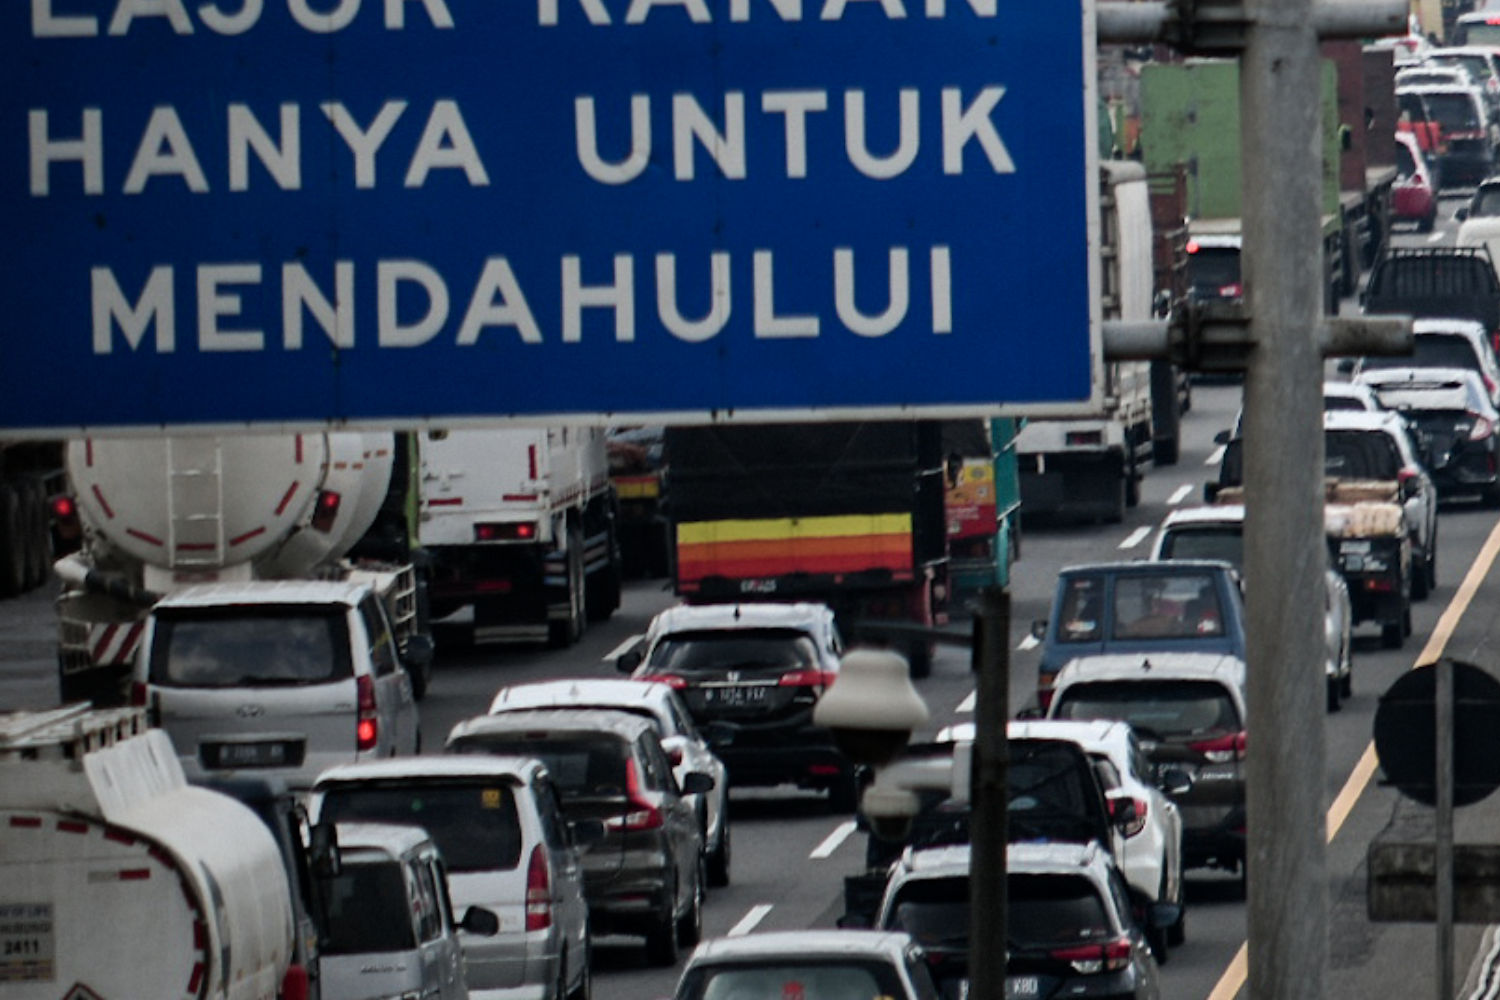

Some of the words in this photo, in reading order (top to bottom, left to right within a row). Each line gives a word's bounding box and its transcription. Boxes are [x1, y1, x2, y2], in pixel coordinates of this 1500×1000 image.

[30, 100, 490, 196] HANYA
[575, 87, 1016, 186] UNTUK
[92, 246, 953, 354] MENDAHULUI
[5, 939, 39, 955] 2411
